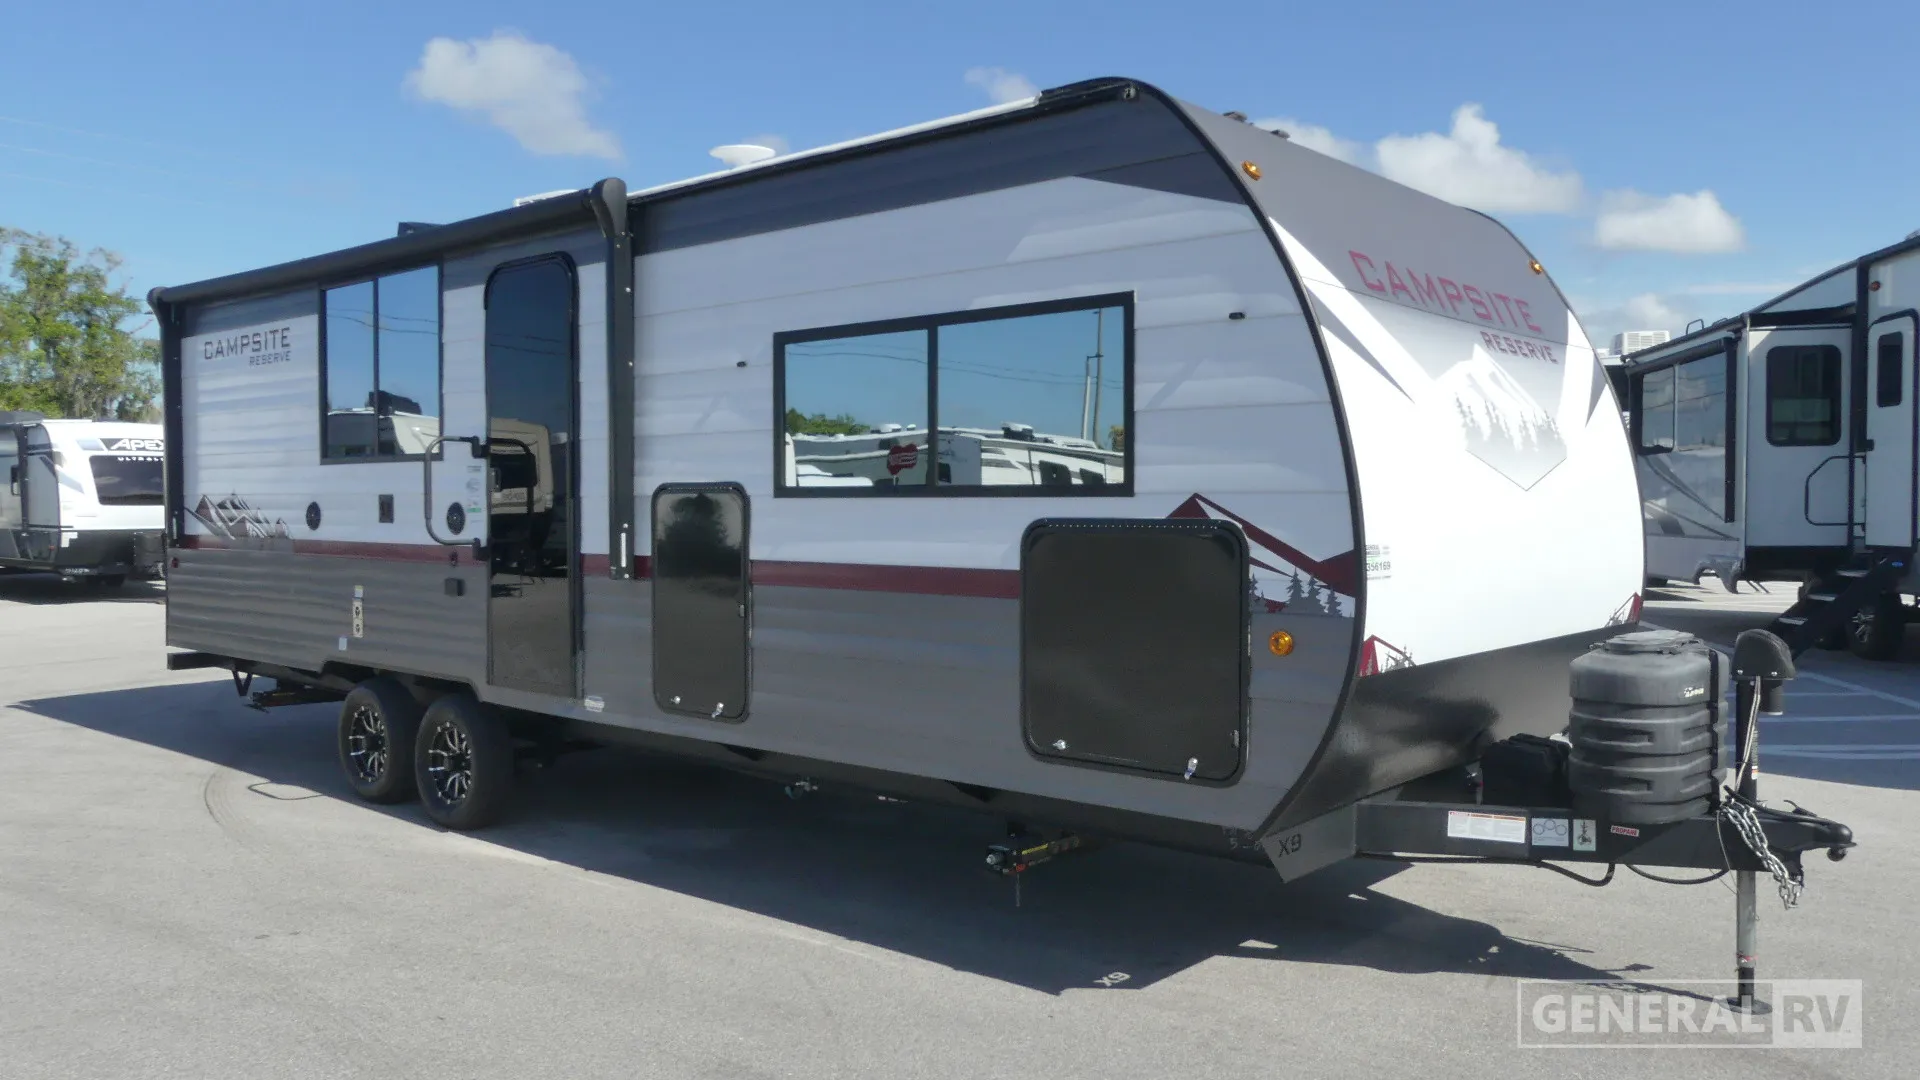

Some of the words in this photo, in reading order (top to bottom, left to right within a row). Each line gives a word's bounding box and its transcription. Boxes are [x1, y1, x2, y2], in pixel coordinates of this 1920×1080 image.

[1348, 249, 1542, 334] CAMPSITE
[204, 327, 291, 360] CAMPSITE
[249, 350, 292, 366] RESERVE
[1480, 330, 1560, 365] RESERVE
[1279, 833, 1302, 858] X9
